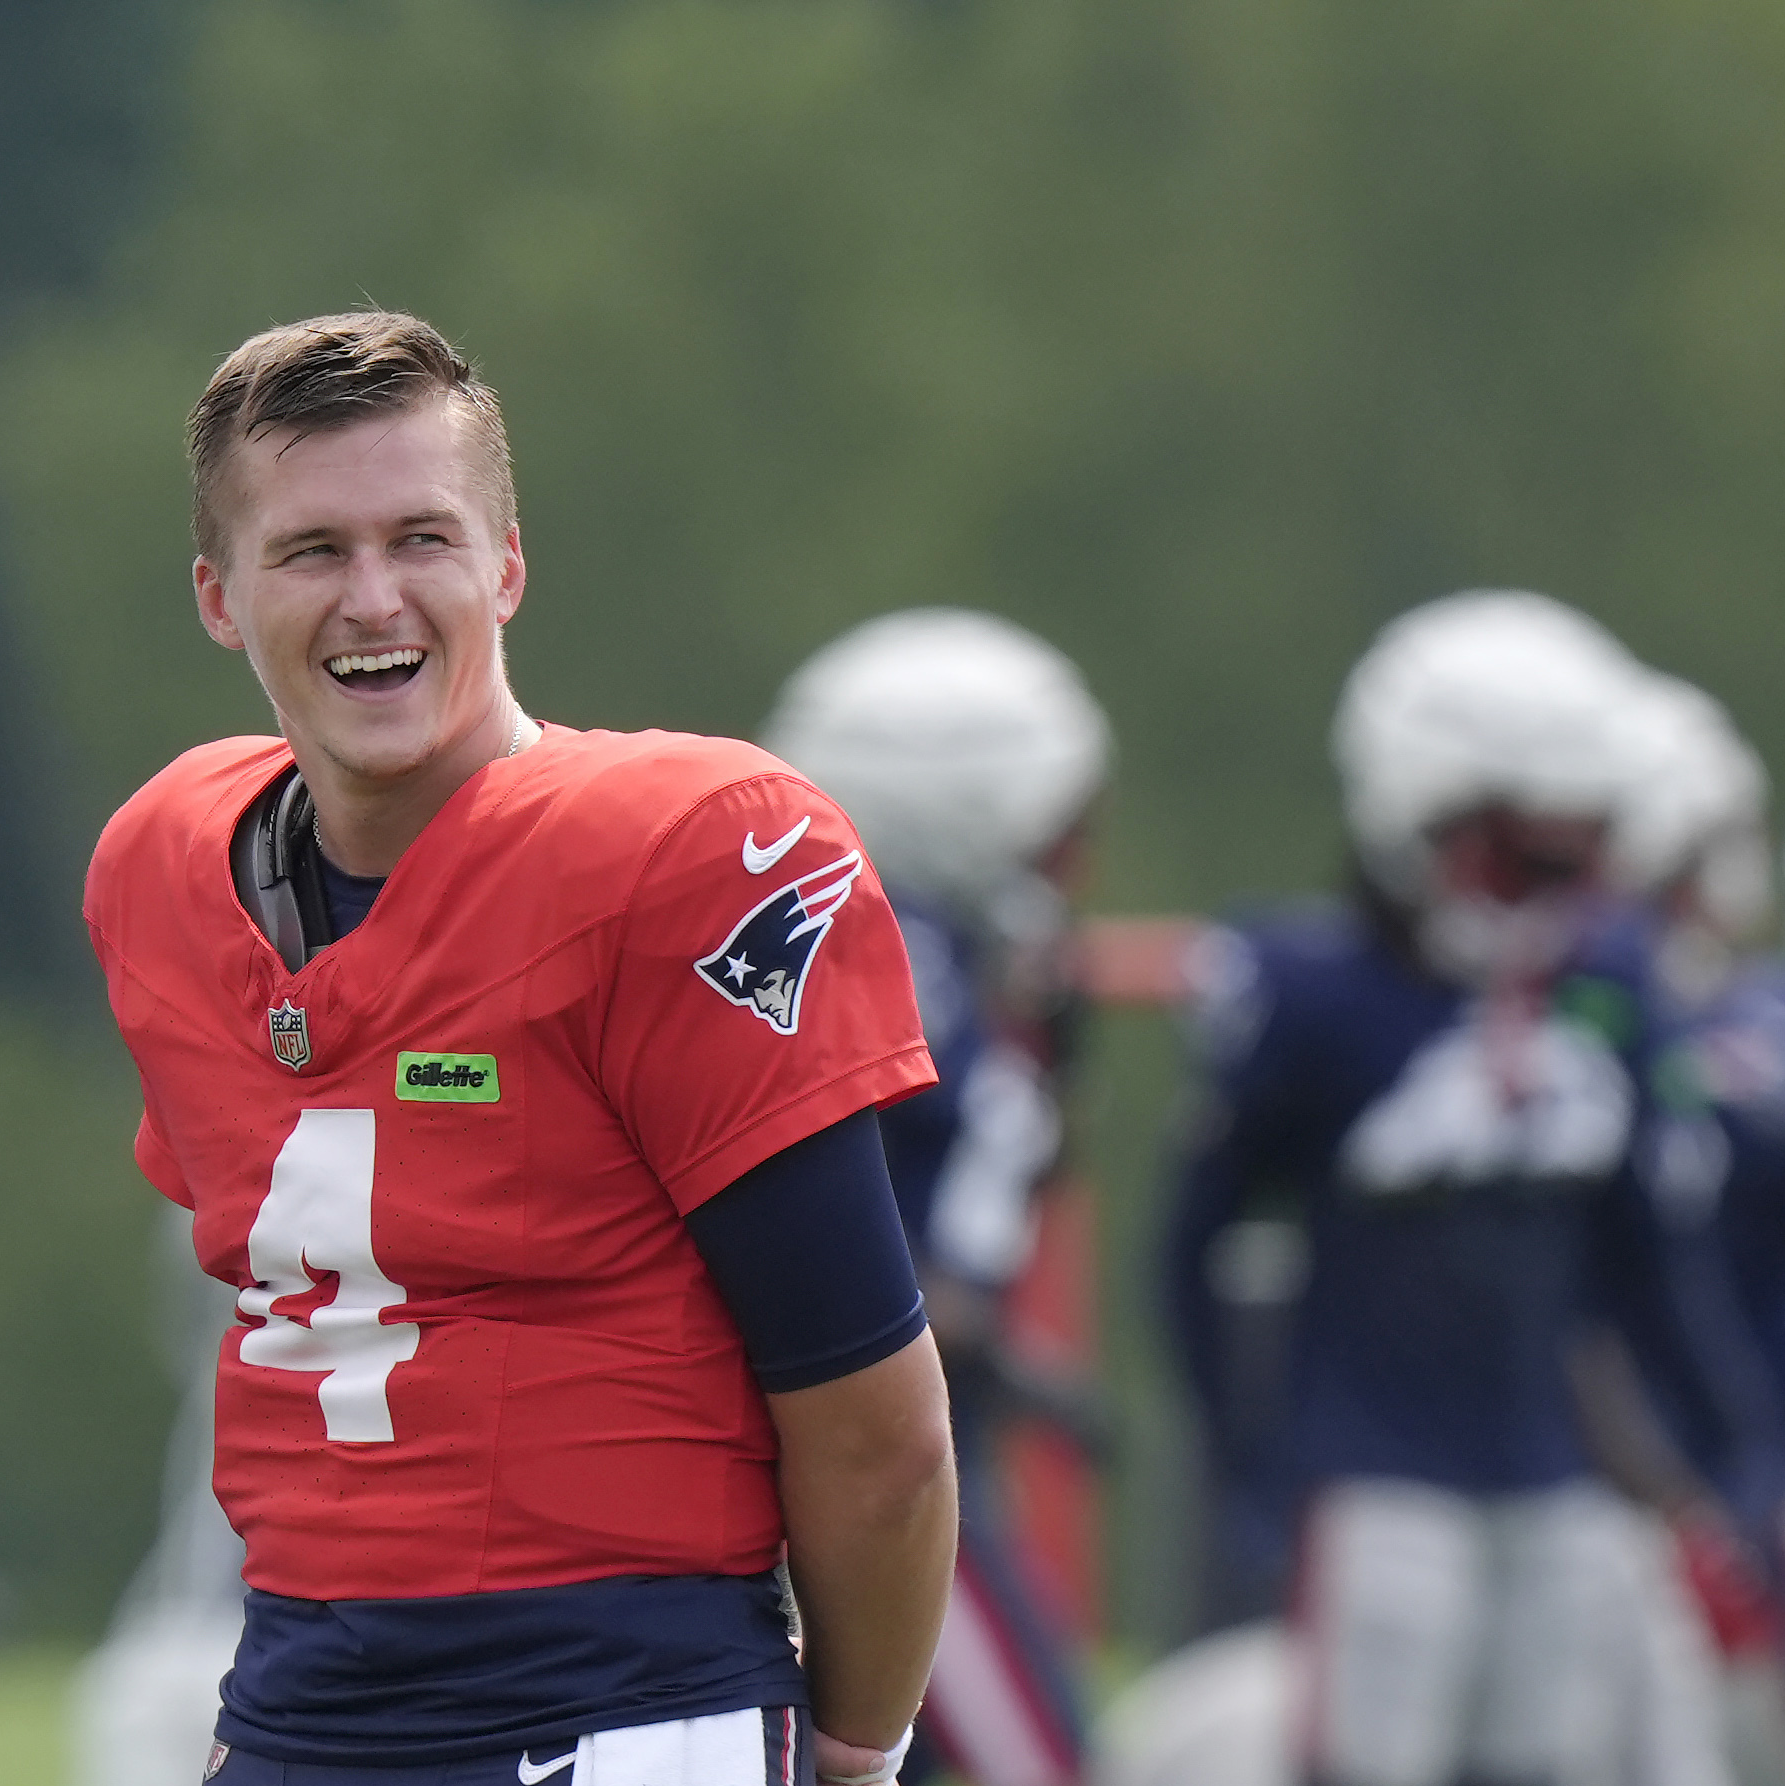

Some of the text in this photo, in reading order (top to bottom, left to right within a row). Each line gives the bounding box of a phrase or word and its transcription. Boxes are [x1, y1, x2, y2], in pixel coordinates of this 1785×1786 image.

[275, 1032, 305, 1058] NFL
[405, 1062, 487, 1088] Gillette
[236, 1109, 420, 1443] 4
